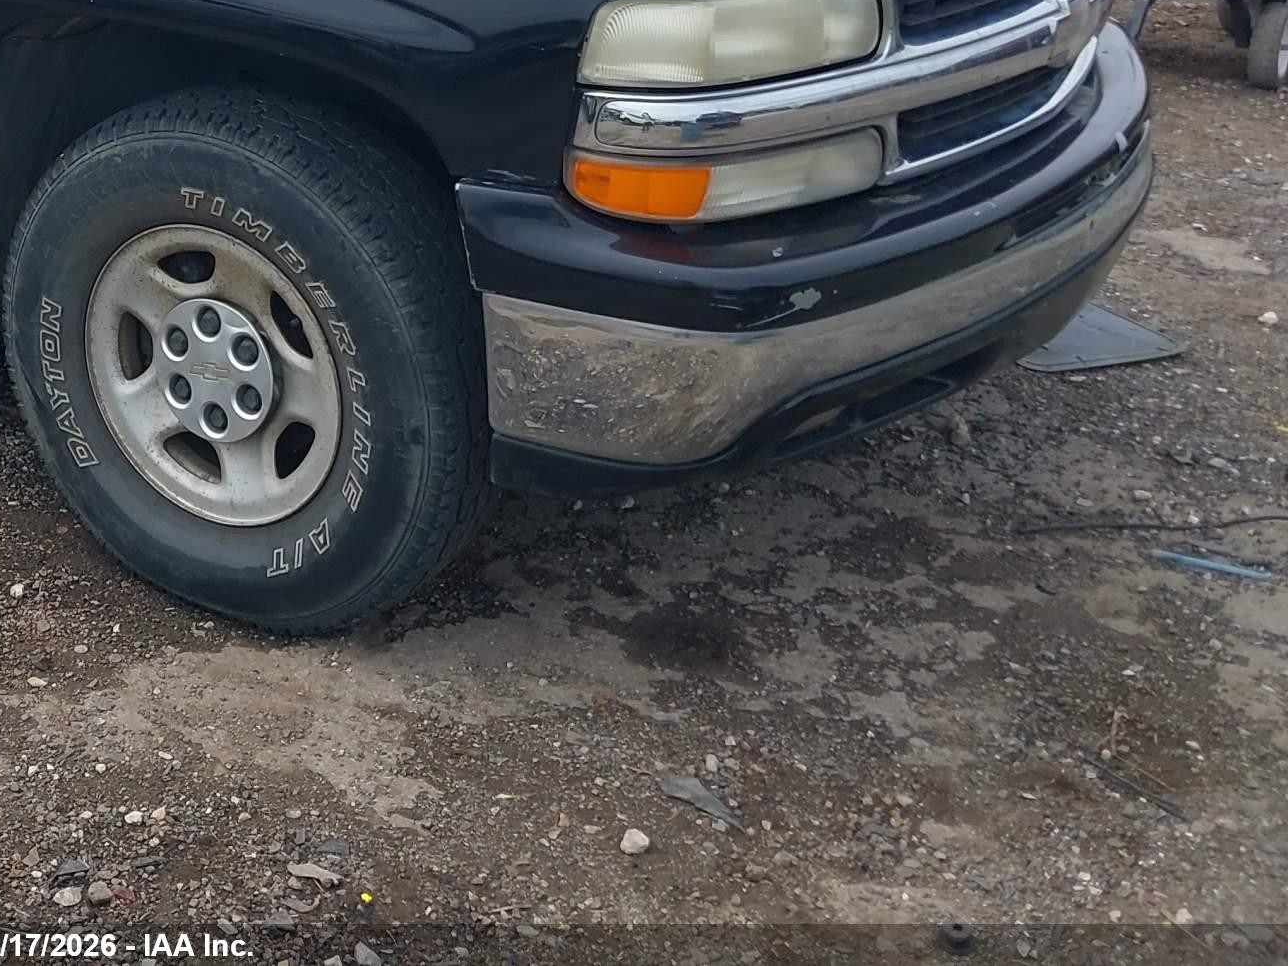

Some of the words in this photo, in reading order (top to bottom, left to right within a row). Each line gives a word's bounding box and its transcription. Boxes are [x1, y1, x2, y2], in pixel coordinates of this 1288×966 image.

[38, 296, 101, 468] DAYTON
[180, 186, 373, 513] TIMBERLINE
[266, 517, 332, 579] A/T
